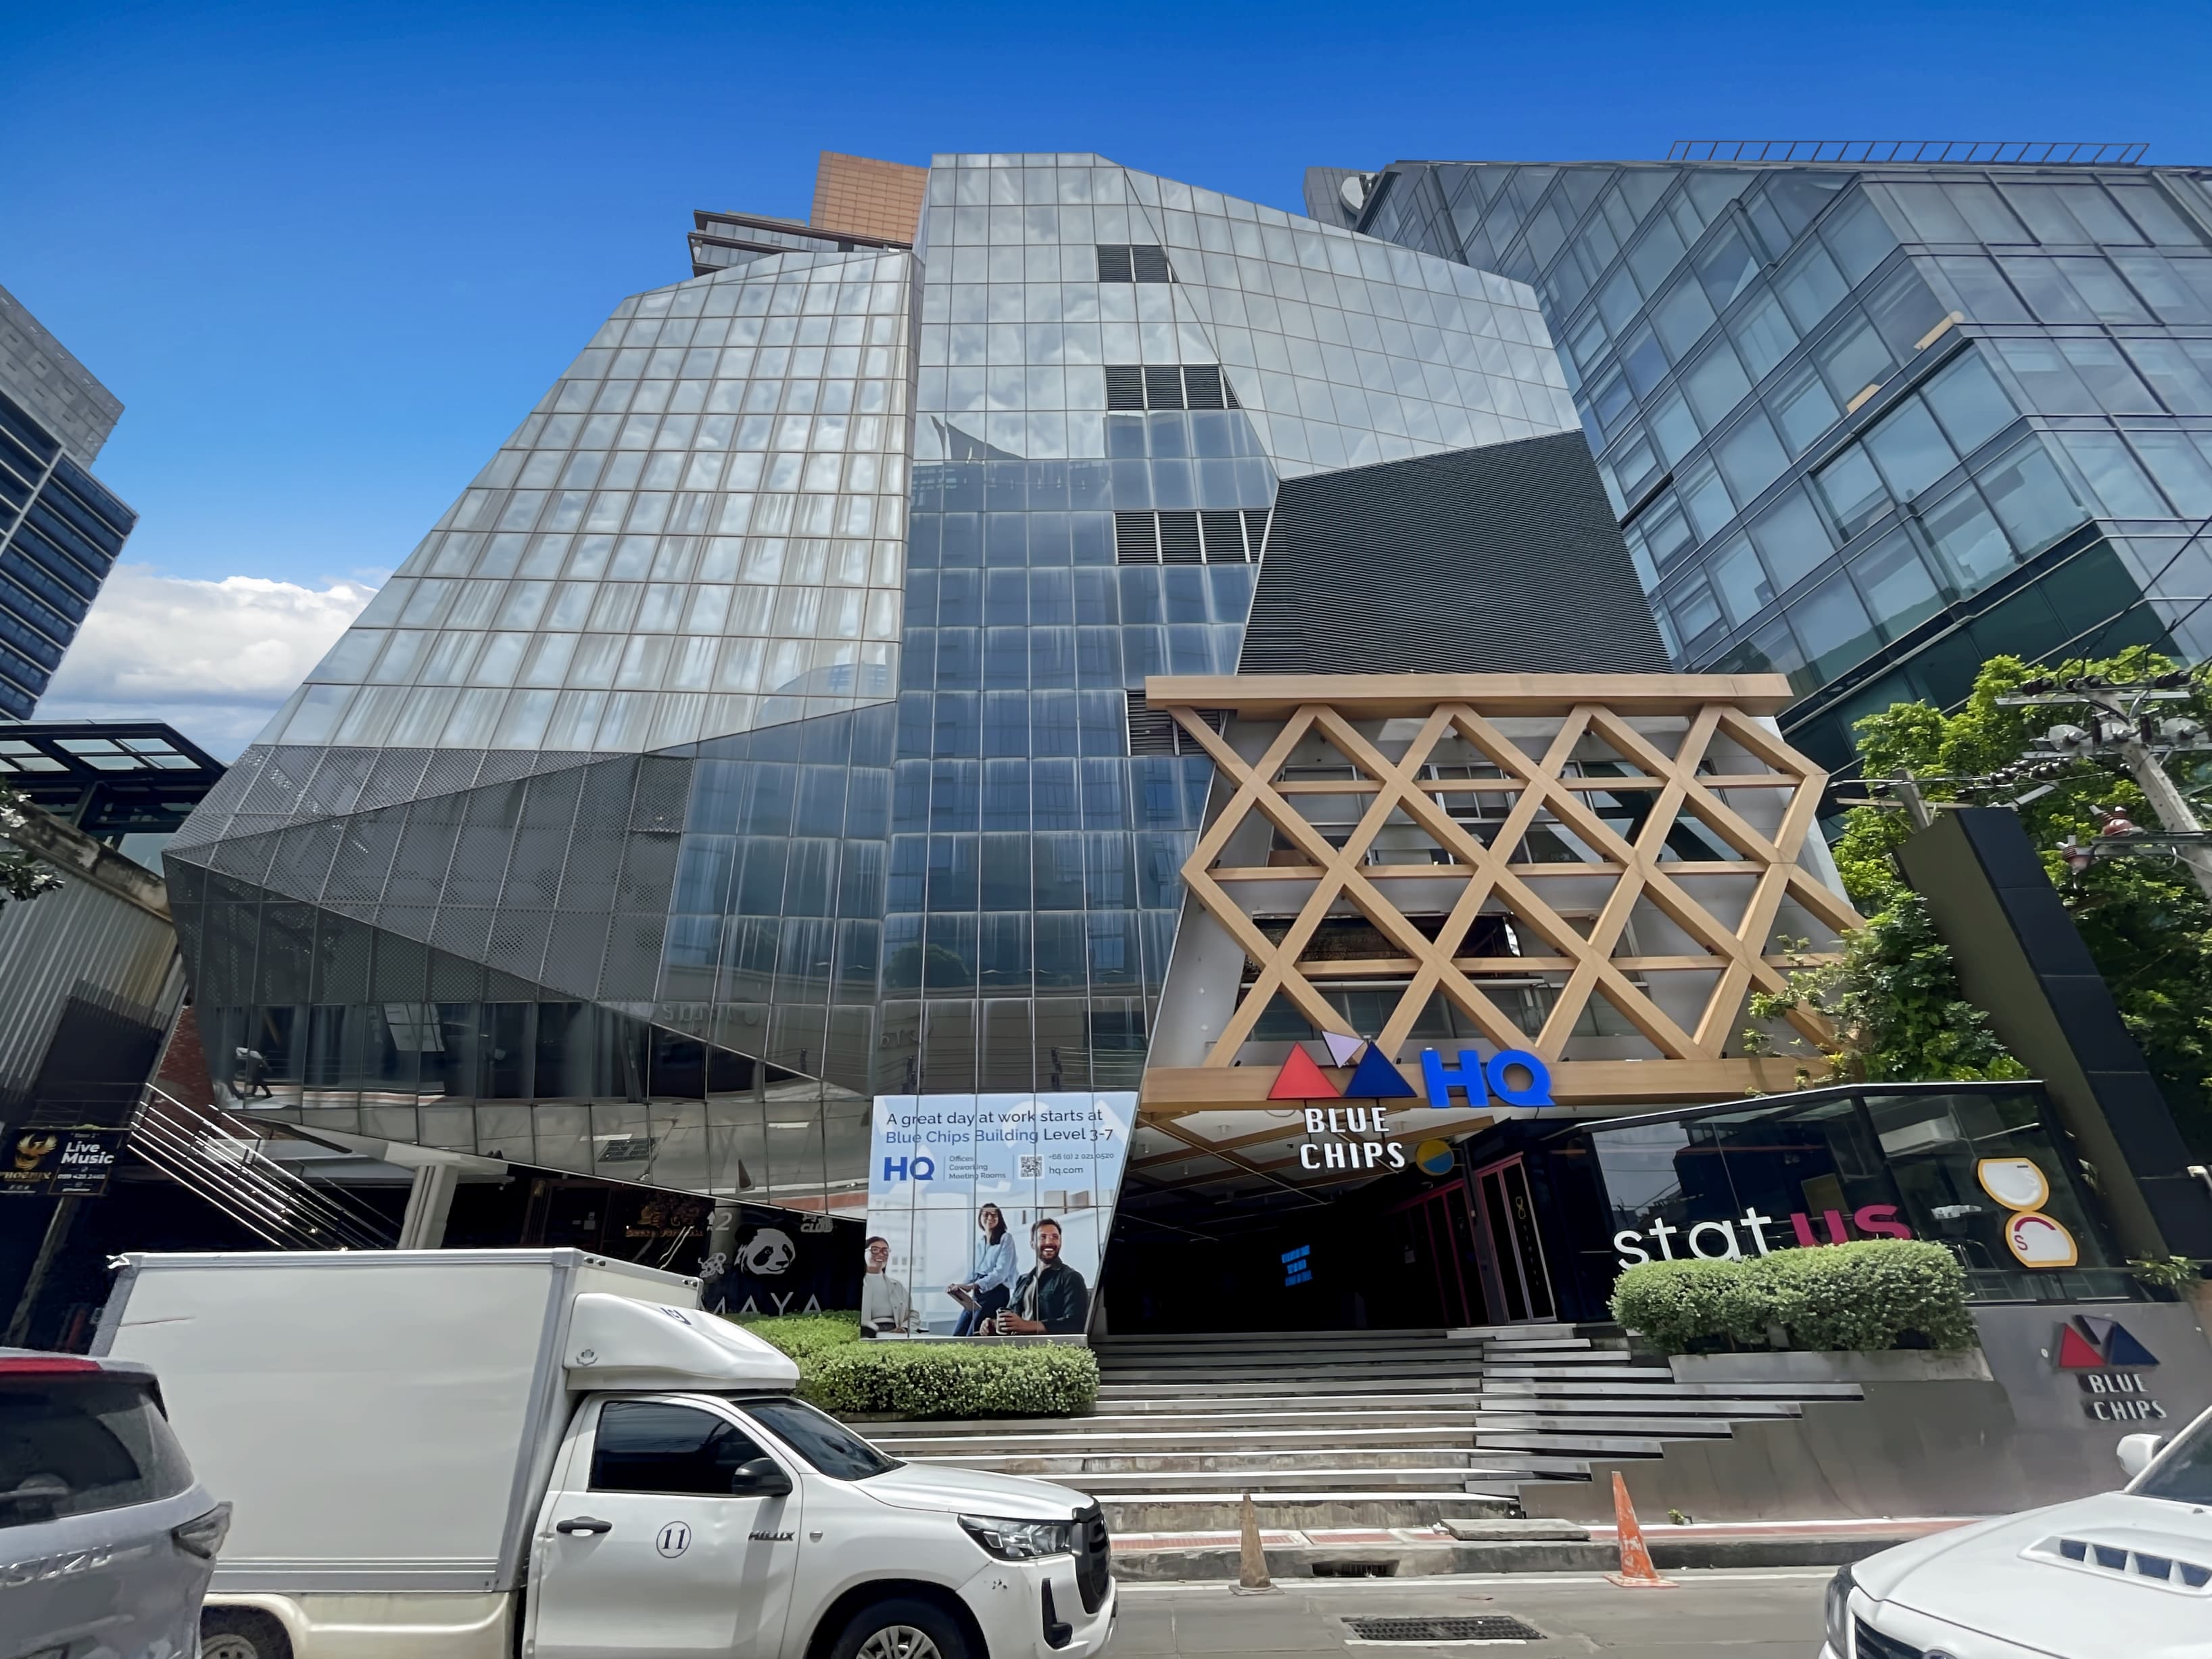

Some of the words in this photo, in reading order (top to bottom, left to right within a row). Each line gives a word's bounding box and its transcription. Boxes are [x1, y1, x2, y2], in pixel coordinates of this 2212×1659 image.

[1422, 1049, 1556, 1108] HQ
[886, 1113, 897, 1125] A
[901, 1113, 942, 1128] great
[947, 1112, 975, 1126] day
[979, 1111, 994, 1123] at
[998, 1110, 1035, 1122] work
[1040, 1110, 1084, 1122] starts
[1088, 1109, 1103, 1121] at
[1304, 1107, 1390, 1133] BLUE
[66, 1140, 100, 1152] Live
[886, 1132, 921, 1144] Blue
[926, 1130, 969, 1145] Chips
[976, 1129, 1038, 1144] Building
[1044, 1128, 1086, 1140] Level
[1090, 1129, 1113, 1141] 3-7
[61, 1151, 114, 1164] Music
[1300, 1142, 1405, 1170] CHIPS
[884, 1157, 935, 1181] HQ
[1049, 1166, 1083, 1176] hq.com
[715, 1212, 733, 1231] 2
[2088, 1373, 2149, 1393] BLUE
[2093, 1400, 2167, 1420] CHIPS
[662, 1528, 686, 1549] 11
[748, 1531, 795, 1541] HILUX
